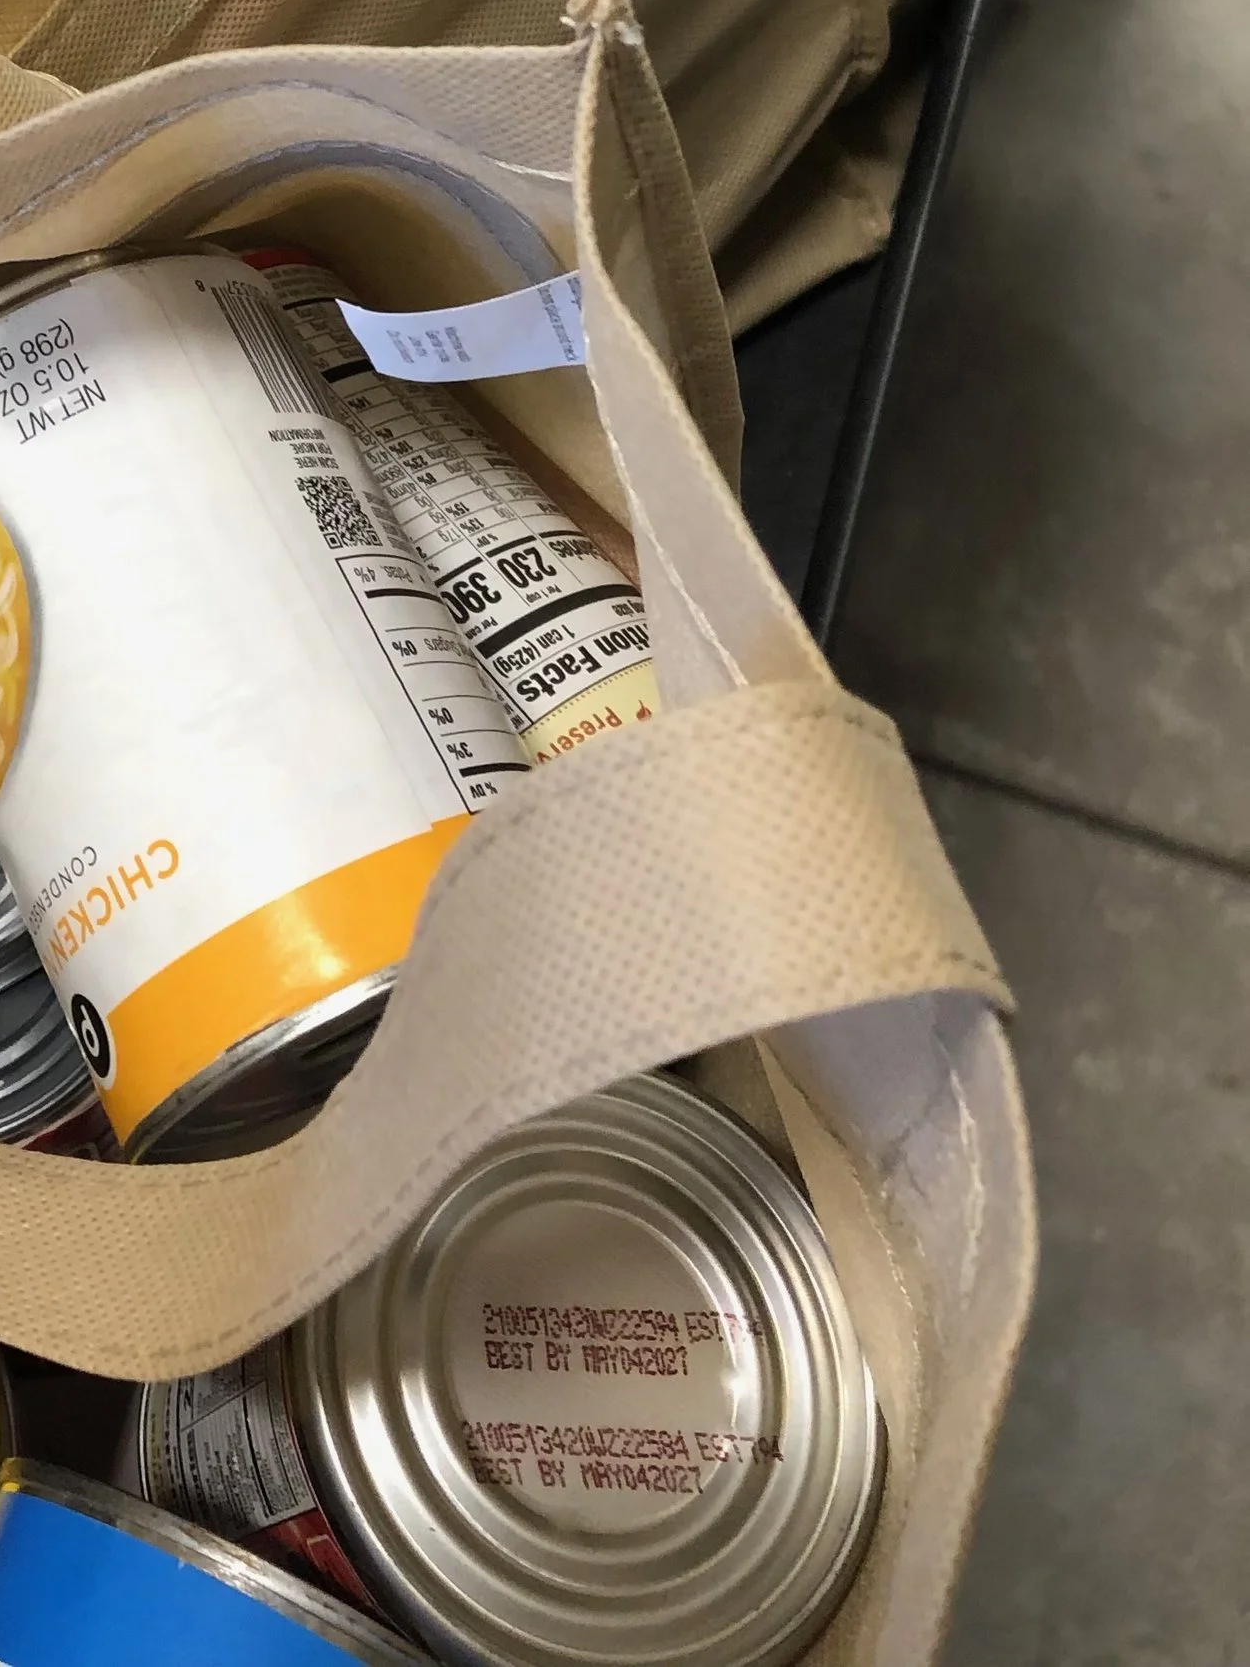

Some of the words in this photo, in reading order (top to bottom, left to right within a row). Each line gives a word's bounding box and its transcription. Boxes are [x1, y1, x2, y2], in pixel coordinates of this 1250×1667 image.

[19, 319, 74, 364] (298
[33, 352, 88, 394] 10.5
[59, 379, 105, 421] NET
[16, 407, 55, 444] WT
[267, 429, 326, 441] INFORMATION
[288, 442, 317, 454] MORE
[293, 456, 318, 468] HERE
[314, 442, 332, 454] FOR
[317, 456, 338, 468] SCAN
[497, 546, 556, 589] 230
[391, 639, 418, 656] 0%
[538, 628, 564, 649] can
[492, 639, 540, 678] (425g)
[517, 646, 600, 702] Facts
[428, 707, 454, 725] 0%
[446, 741, 473, 759] 3%
[51, 840, 179, 958] CHICKEN
[484, 1340, 533, 1371] BEST
[544, 1341, 571, 1371] BY
[470, 1456, 523, 1486] BEST
[537, 1459, 566, 1487] BY
